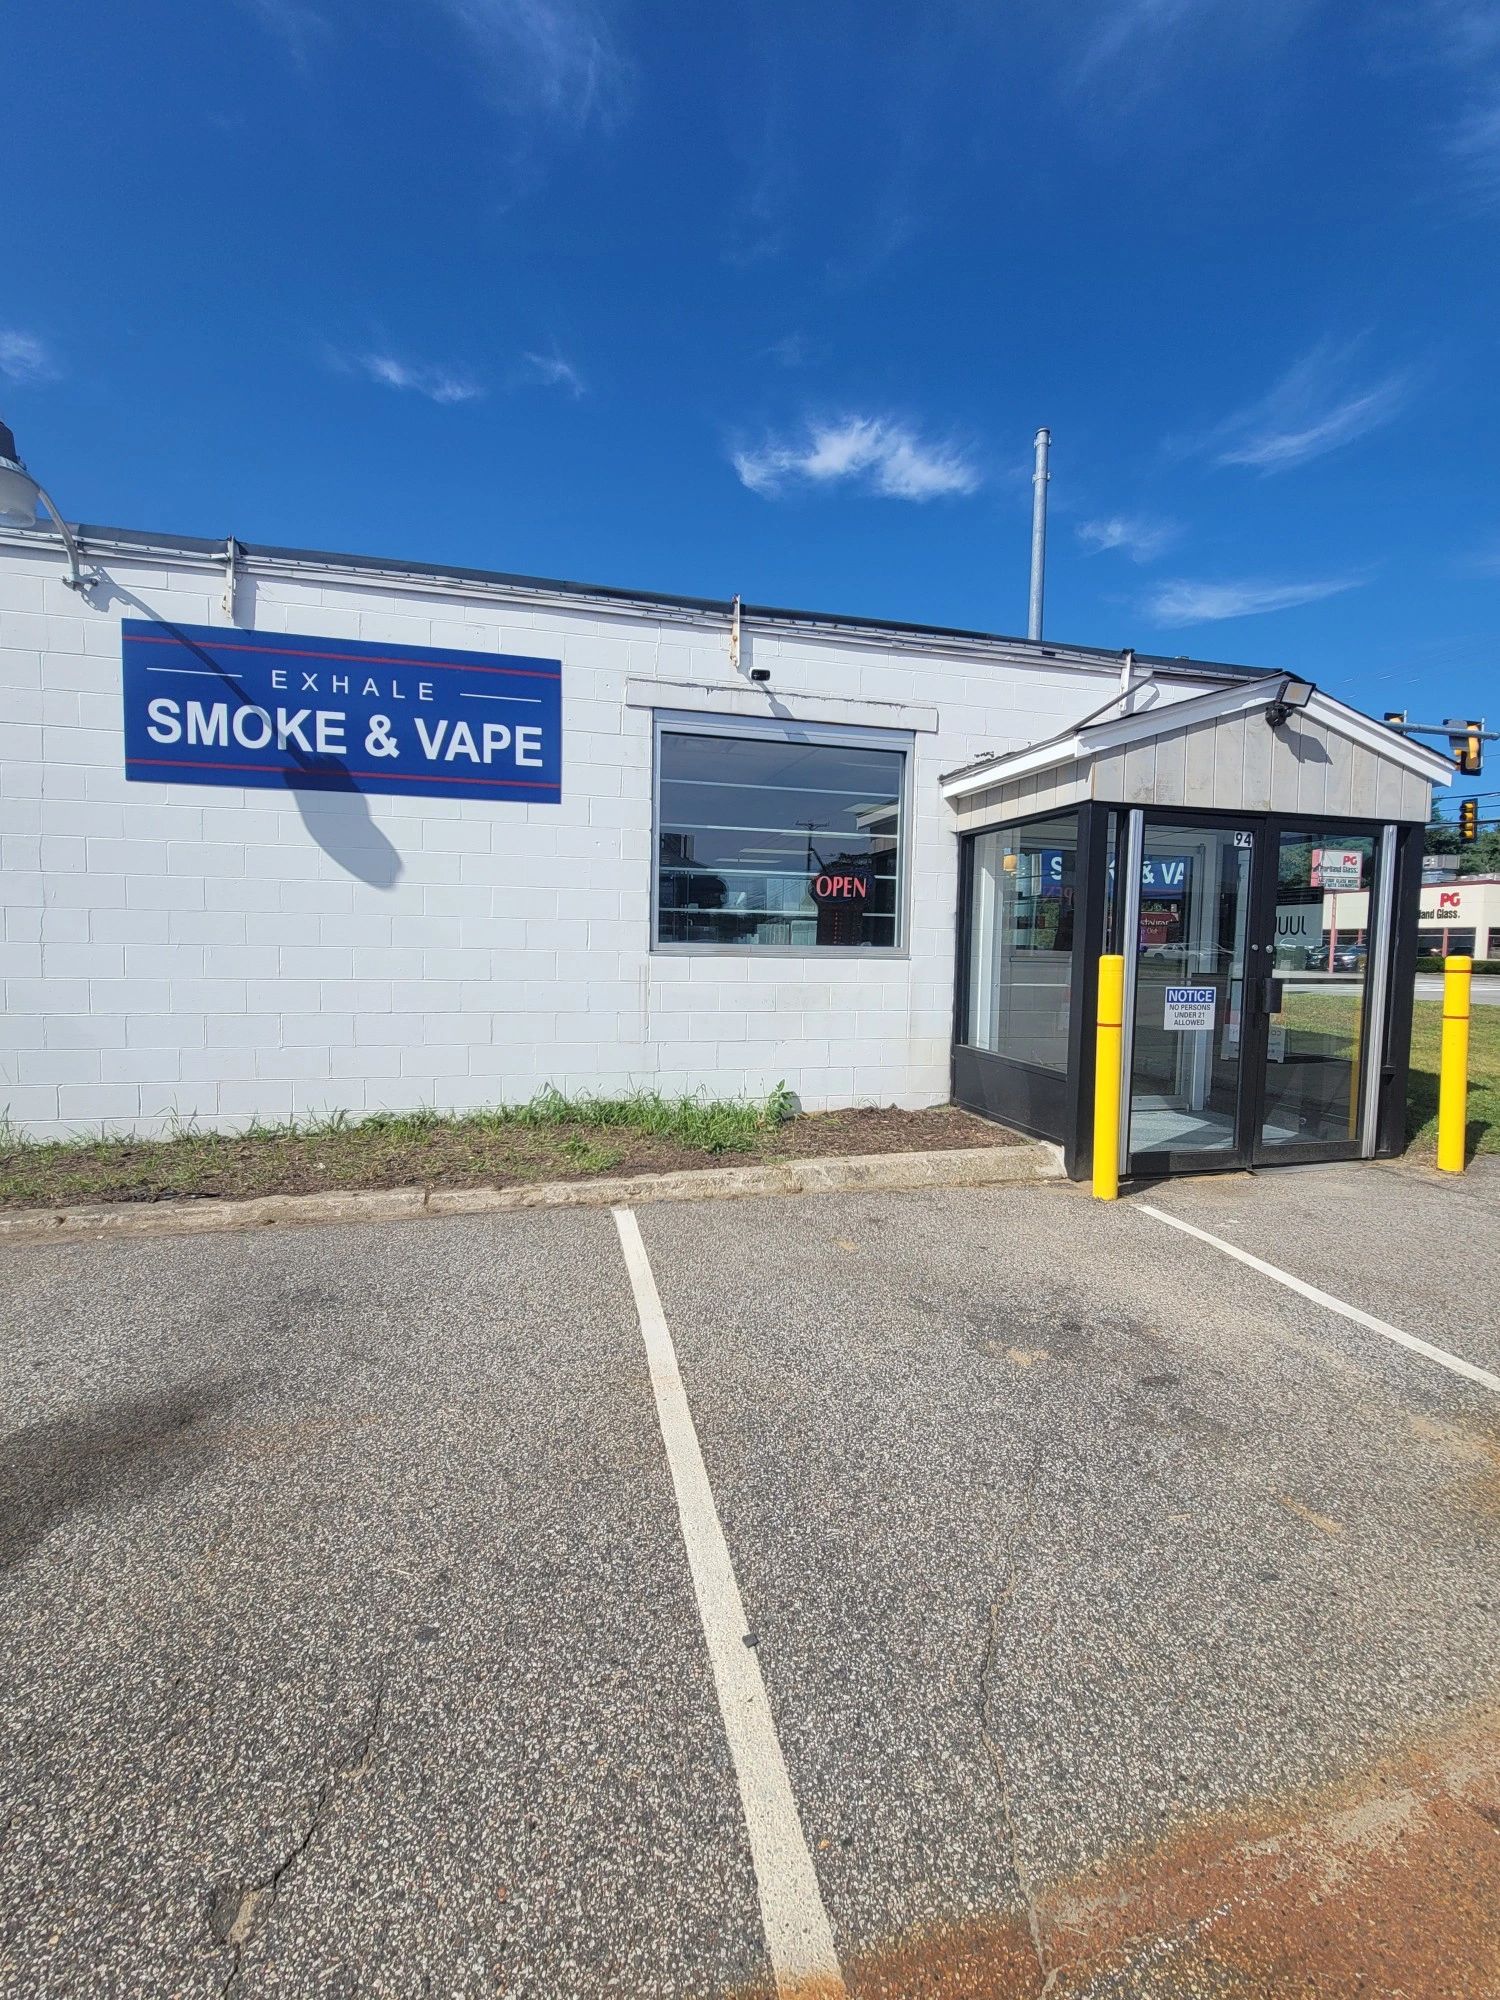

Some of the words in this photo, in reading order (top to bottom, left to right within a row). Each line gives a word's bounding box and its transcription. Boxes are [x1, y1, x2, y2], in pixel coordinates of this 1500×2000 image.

[271, 670, 434, 701] EXHALE
[146, 698, 347, 755] SMOKE
[364, 714, 400, 758] &
[413, 717, 544, 767] VAPE
[1235, 832, 1252, 847] 94
[1343, 855, 1358, 866] PG
[816, 876, 866, 897] OPEN
[1440, 892, 1461, 907] PG
[1418, 909, 1435, 919] land
[1168, 990, 1213, 1002] NOTICE
